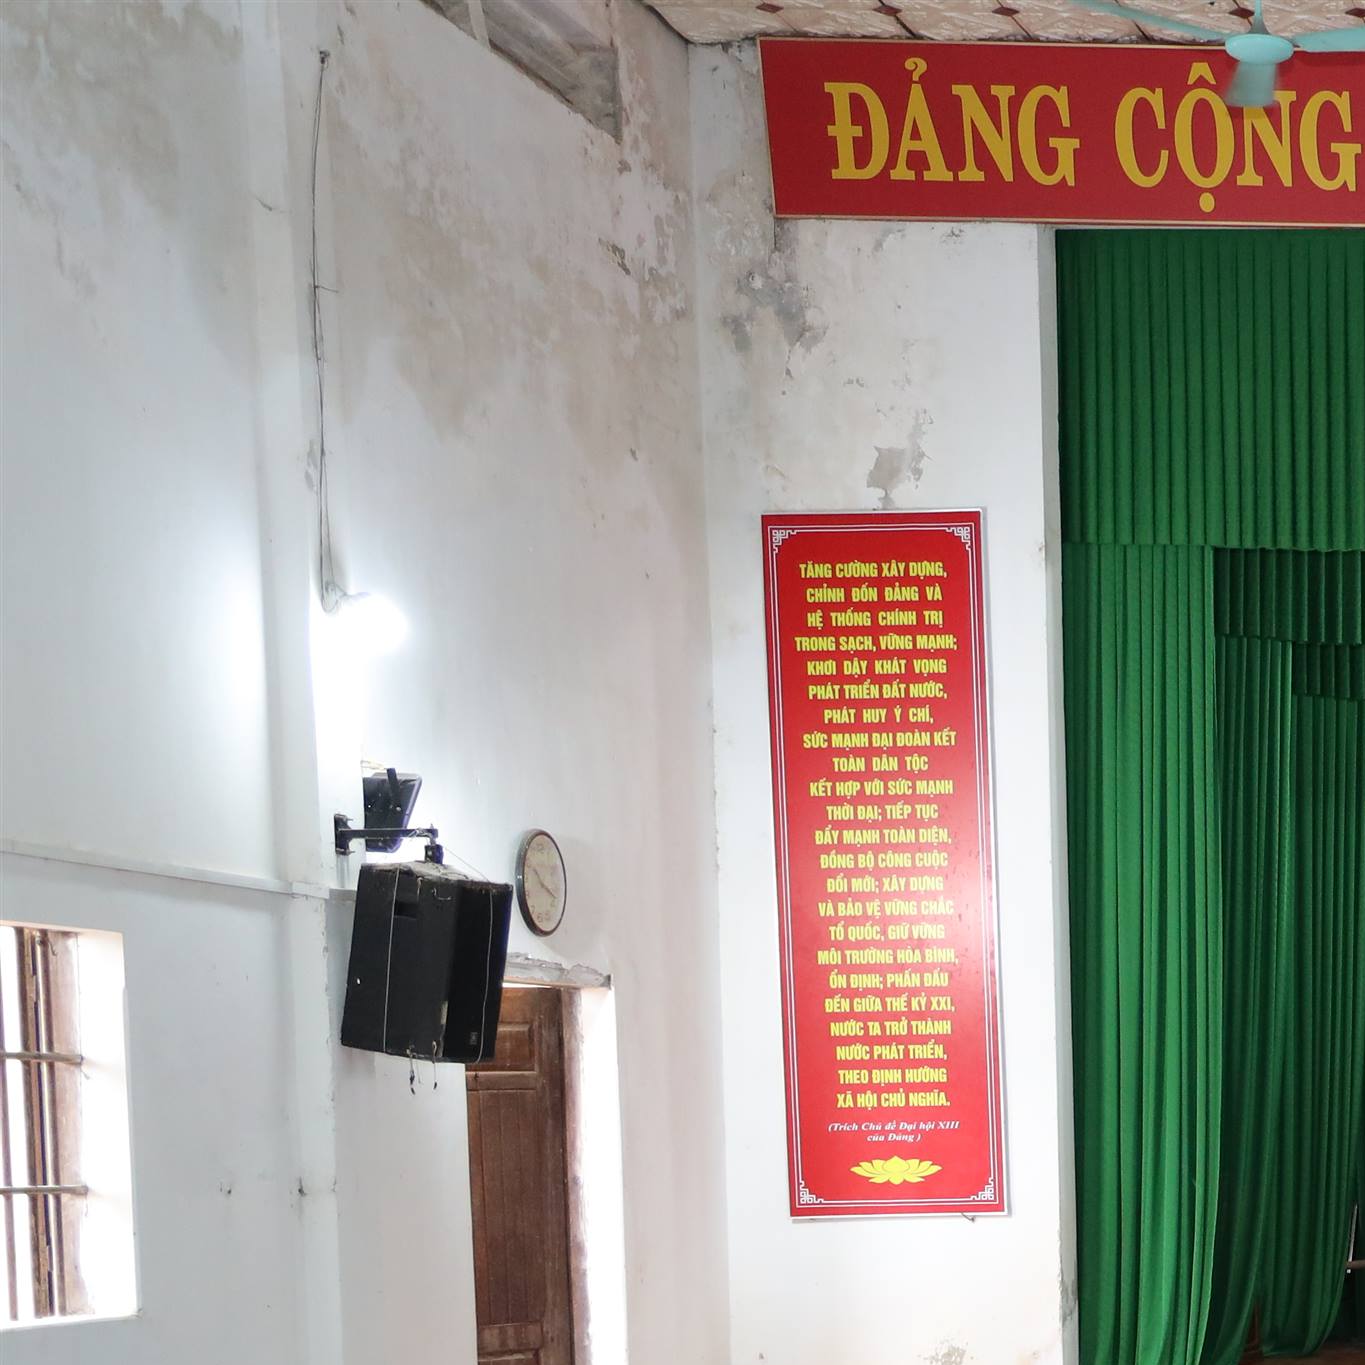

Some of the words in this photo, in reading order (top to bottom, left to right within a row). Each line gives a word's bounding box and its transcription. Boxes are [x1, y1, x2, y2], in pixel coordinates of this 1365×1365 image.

[826, 58, 1080, 187] ĐẢNG
[1118, 62, 1361, 214] CỘNG
[800, 561, 832, 578] TĂNG
[835, 560, 878, 578] CƯỜNG
[881, 560, 906, 577] XÂY
[909, 561, 947, 579] DỰNG,
[806, 583, 845, 602] CHỈNH
[852, 583, 877, 602] ĐỐN
[885, 582, 919, 602] ĐẢNG
[925, 583, 942, 601] VÀ
[807, 610, 824, 630] HỆ
[830, 607, 871, 627] THỐNG
[878, 608, 917, 626] CHÍNH
[923, 611, 943, 628] TRỊ
[794, 636, 836, 651] TRONG
[839, 636, 876, 654] SẠCH,
[879, 633, 913, 650] VỮNG
[916, 634, 957, 653] MẠNH;
[807, 659, 836, 676] KHƠI
[843, 657, 867, 678] DẬY
[875, 657, 907, 675] KHÁT
[913, 659, 947, 677] VỌNG
[808, 682, 840, 700] PHÁT
[844, 679, 880, 699] TRIỂN
[882, 679, 907, 698] ĐẤT
[910, 680, 948, 699] NƯỚC,
[836, 1091, 854, 1108] XÃ
[857, 1090, 877, 1111] HỘI
[880, 1088, 906, 1107] CHỦ
[909, 1090, 951, 1107] NGHĨA.
